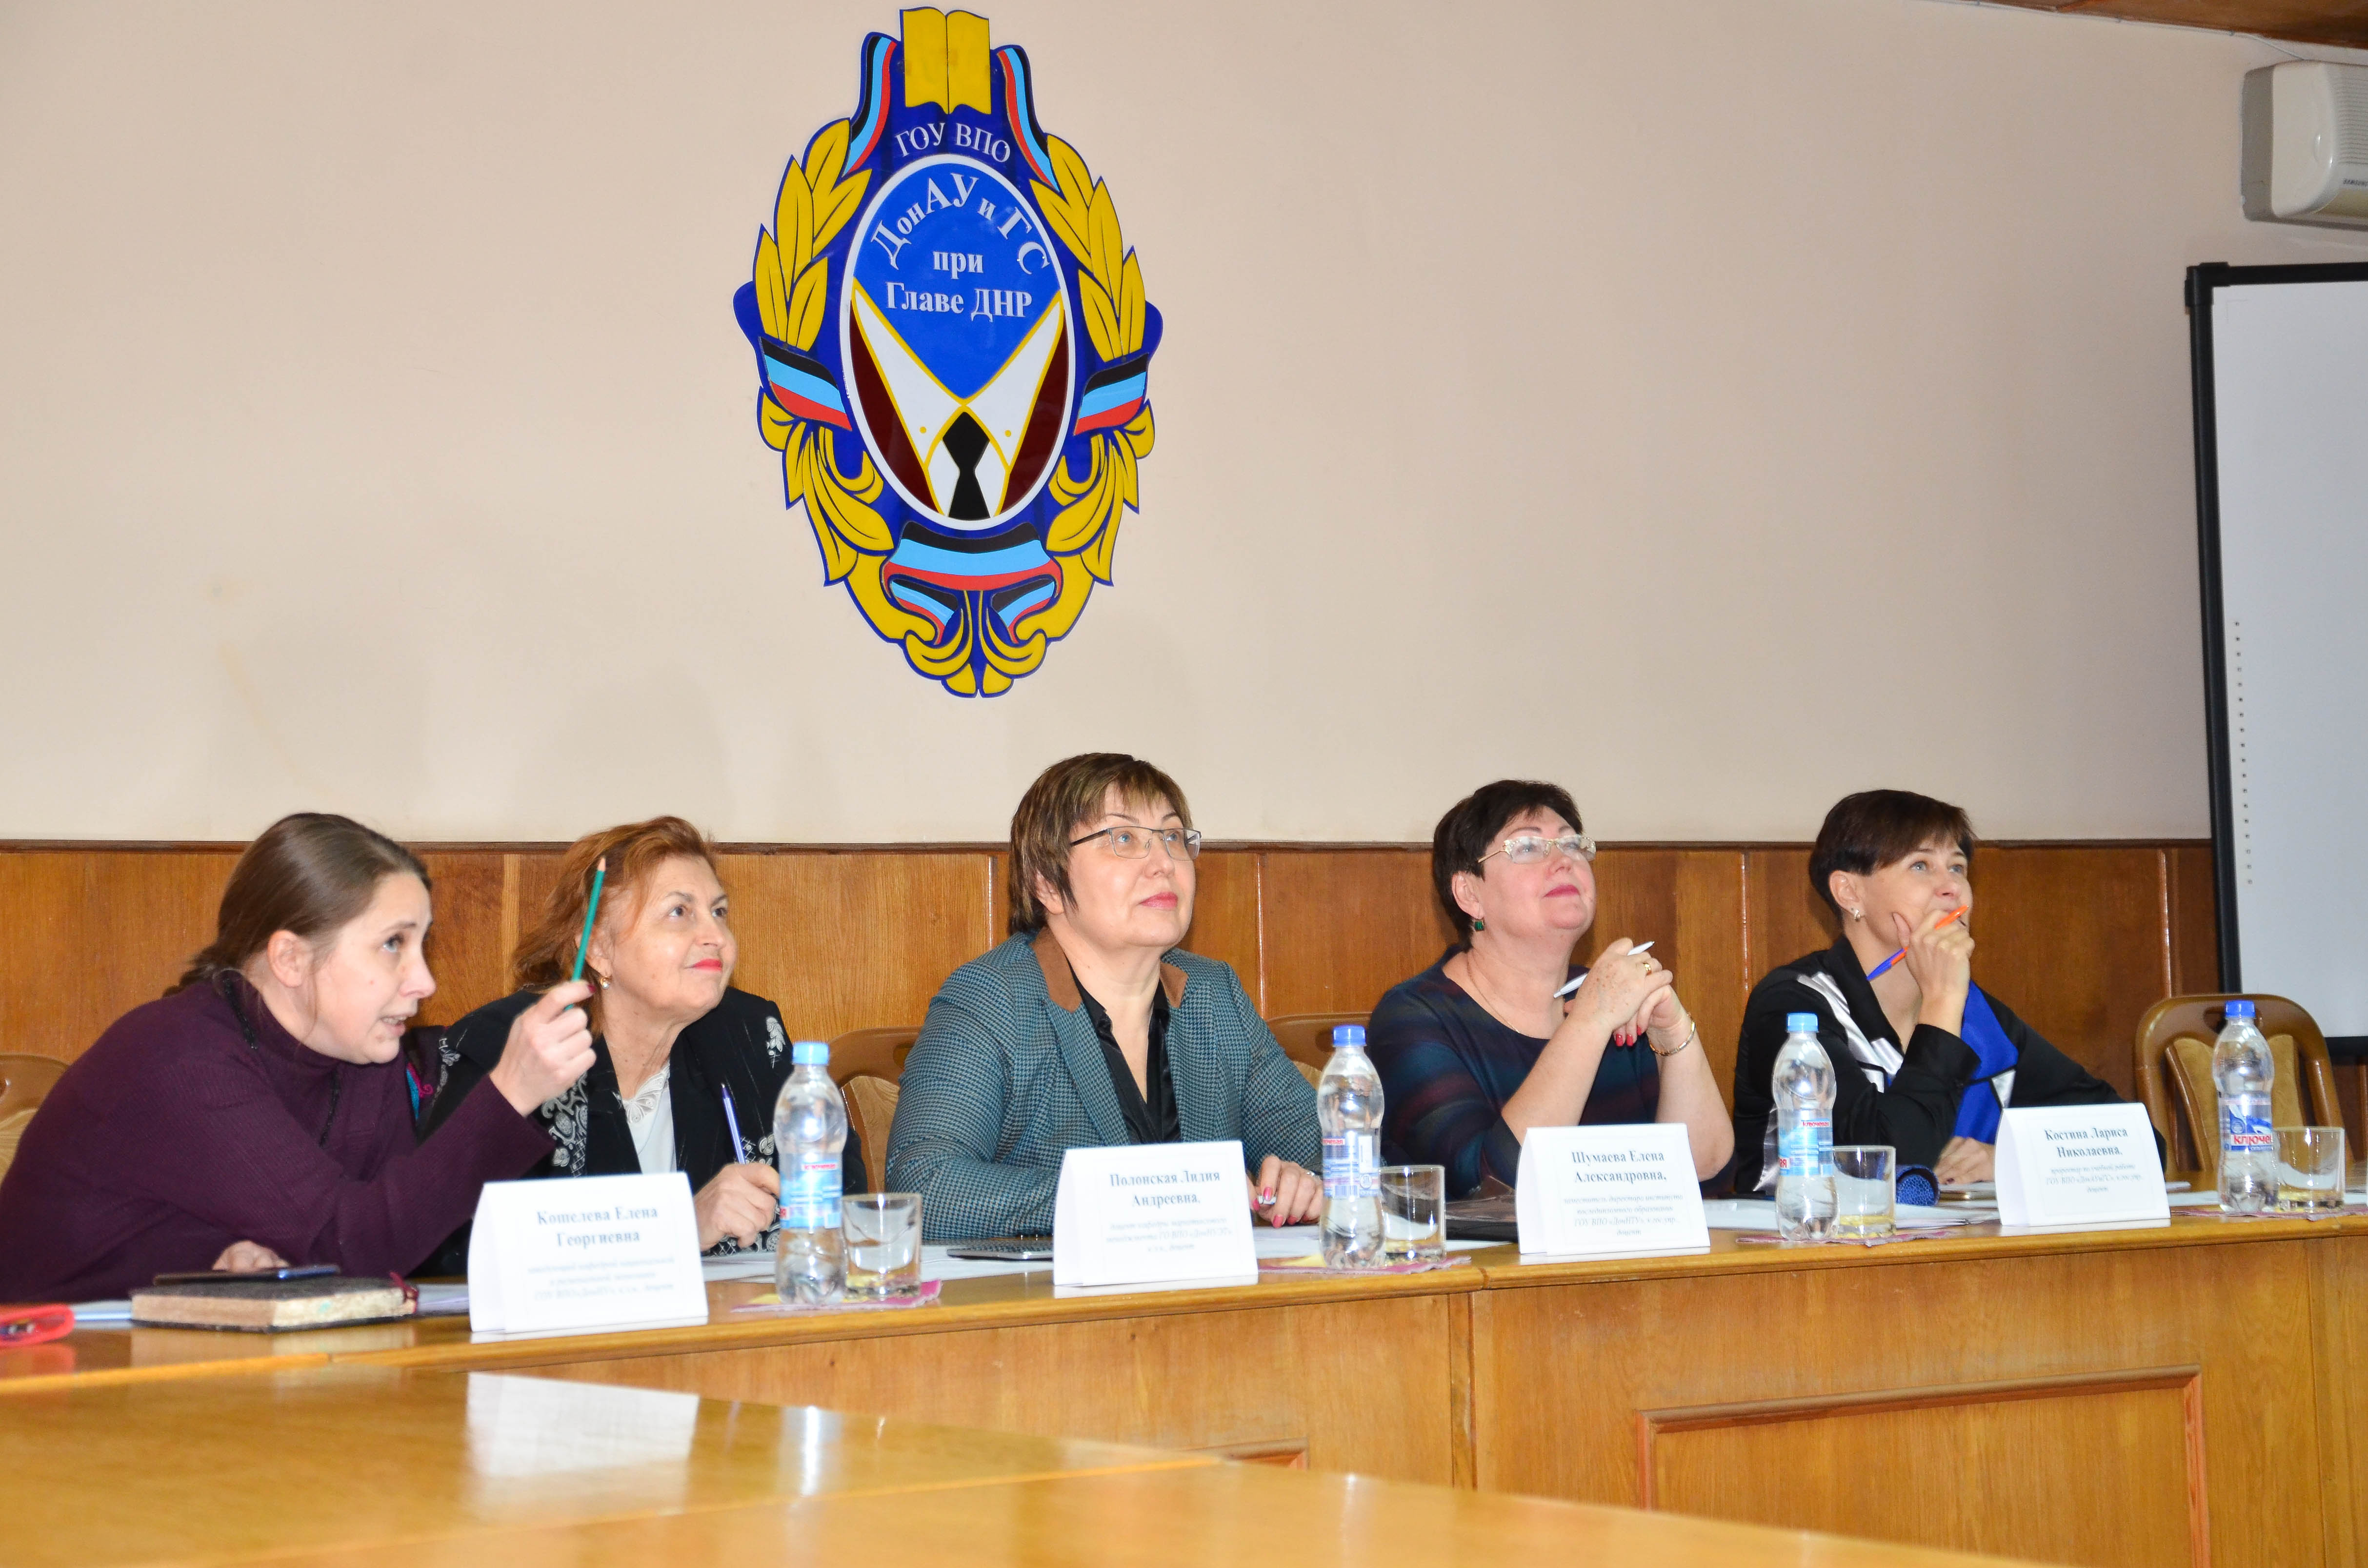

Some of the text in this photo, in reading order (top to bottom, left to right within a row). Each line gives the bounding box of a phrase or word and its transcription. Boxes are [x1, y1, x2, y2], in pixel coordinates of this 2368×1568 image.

[895, 122, 1011, 163] ГОУ ВПО
[870, 172, 980, 271] ДонАУ
[977, 198, 997, 221] и
[933, 251, 984, 280] при
[885, 282, 1032, 323] Главе ДНР
[2044, 1127, 2128, 1141] Костина Лариса
[1571, 1150, 1665, 1166] Шумаева Елена
[1109, 1171, 1221, 1187] Полонская Лидия
[1575, 1171, 1666, 1184] Александровна,
[536, 1206, 659, 1225] Кошелева Елена
[556, 1231, 641, 1249] Георгиевна
